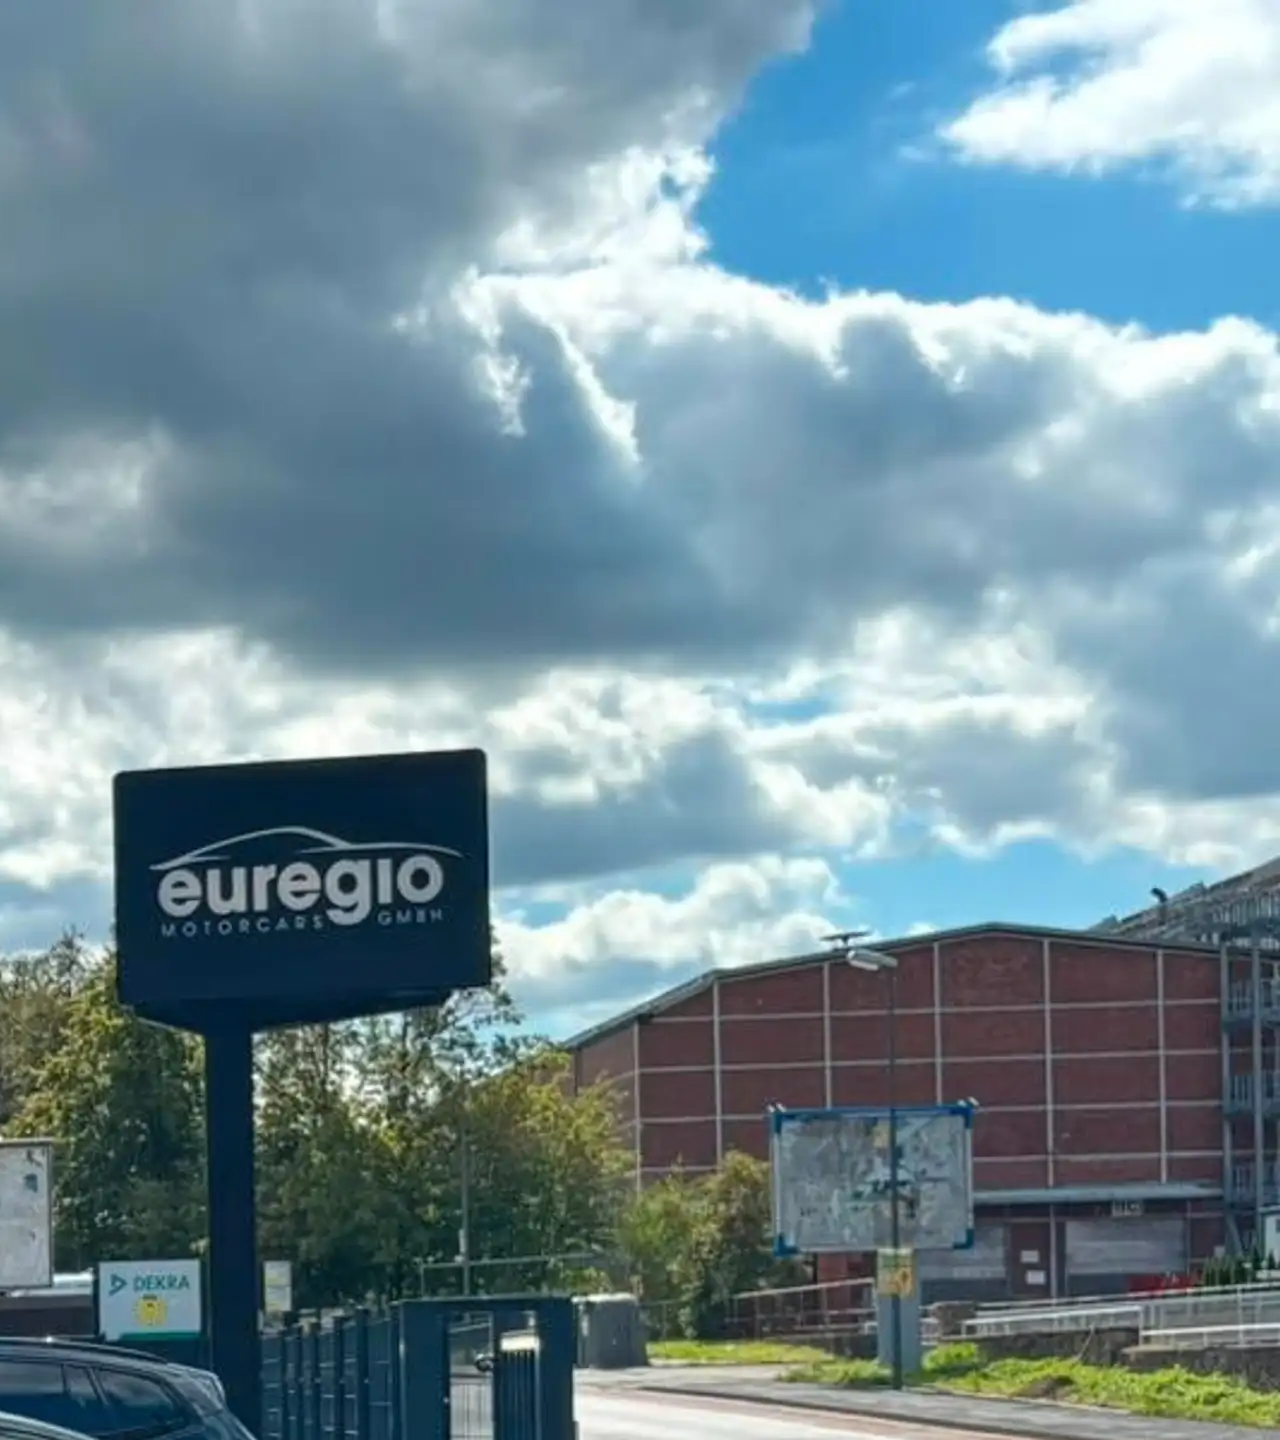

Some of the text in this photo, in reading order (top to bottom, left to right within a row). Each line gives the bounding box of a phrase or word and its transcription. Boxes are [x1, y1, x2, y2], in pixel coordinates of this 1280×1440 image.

[158, 854, 444, 926] euregio
[161, 914, 324, 937] MOTORCARS
[132, 1274, 190, 1291] DEKRA
